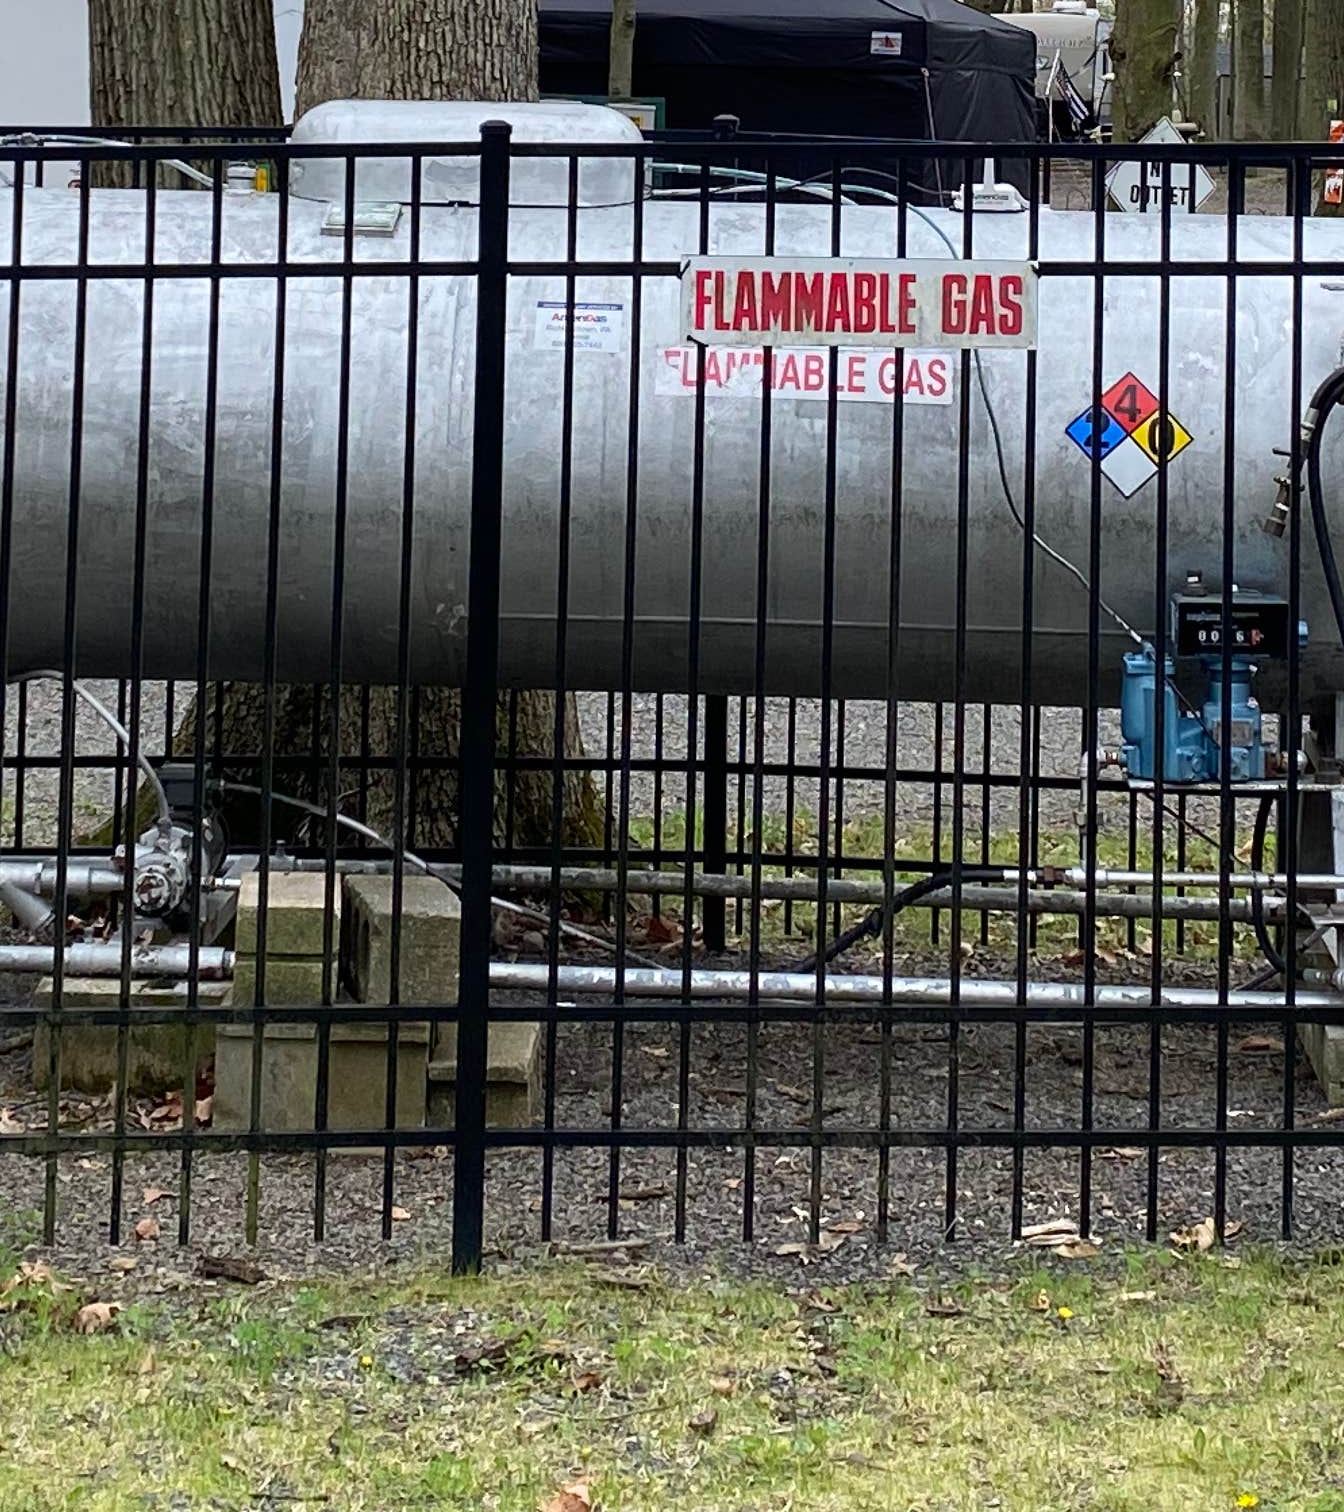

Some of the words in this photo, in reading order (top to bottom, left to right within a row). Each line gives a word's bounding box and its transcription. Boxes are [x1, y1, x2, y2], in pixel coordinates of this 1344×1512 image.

[694, 270, 917, 334] FLAMMABLE
[941, 272, 1023, 336] GAS
[878, 357, 947, 397] GAS
[1114, 384, 1142, 423] 4
[1083, 411, 1111, 449] 2
[1148, 416, 1175, 457] 0
